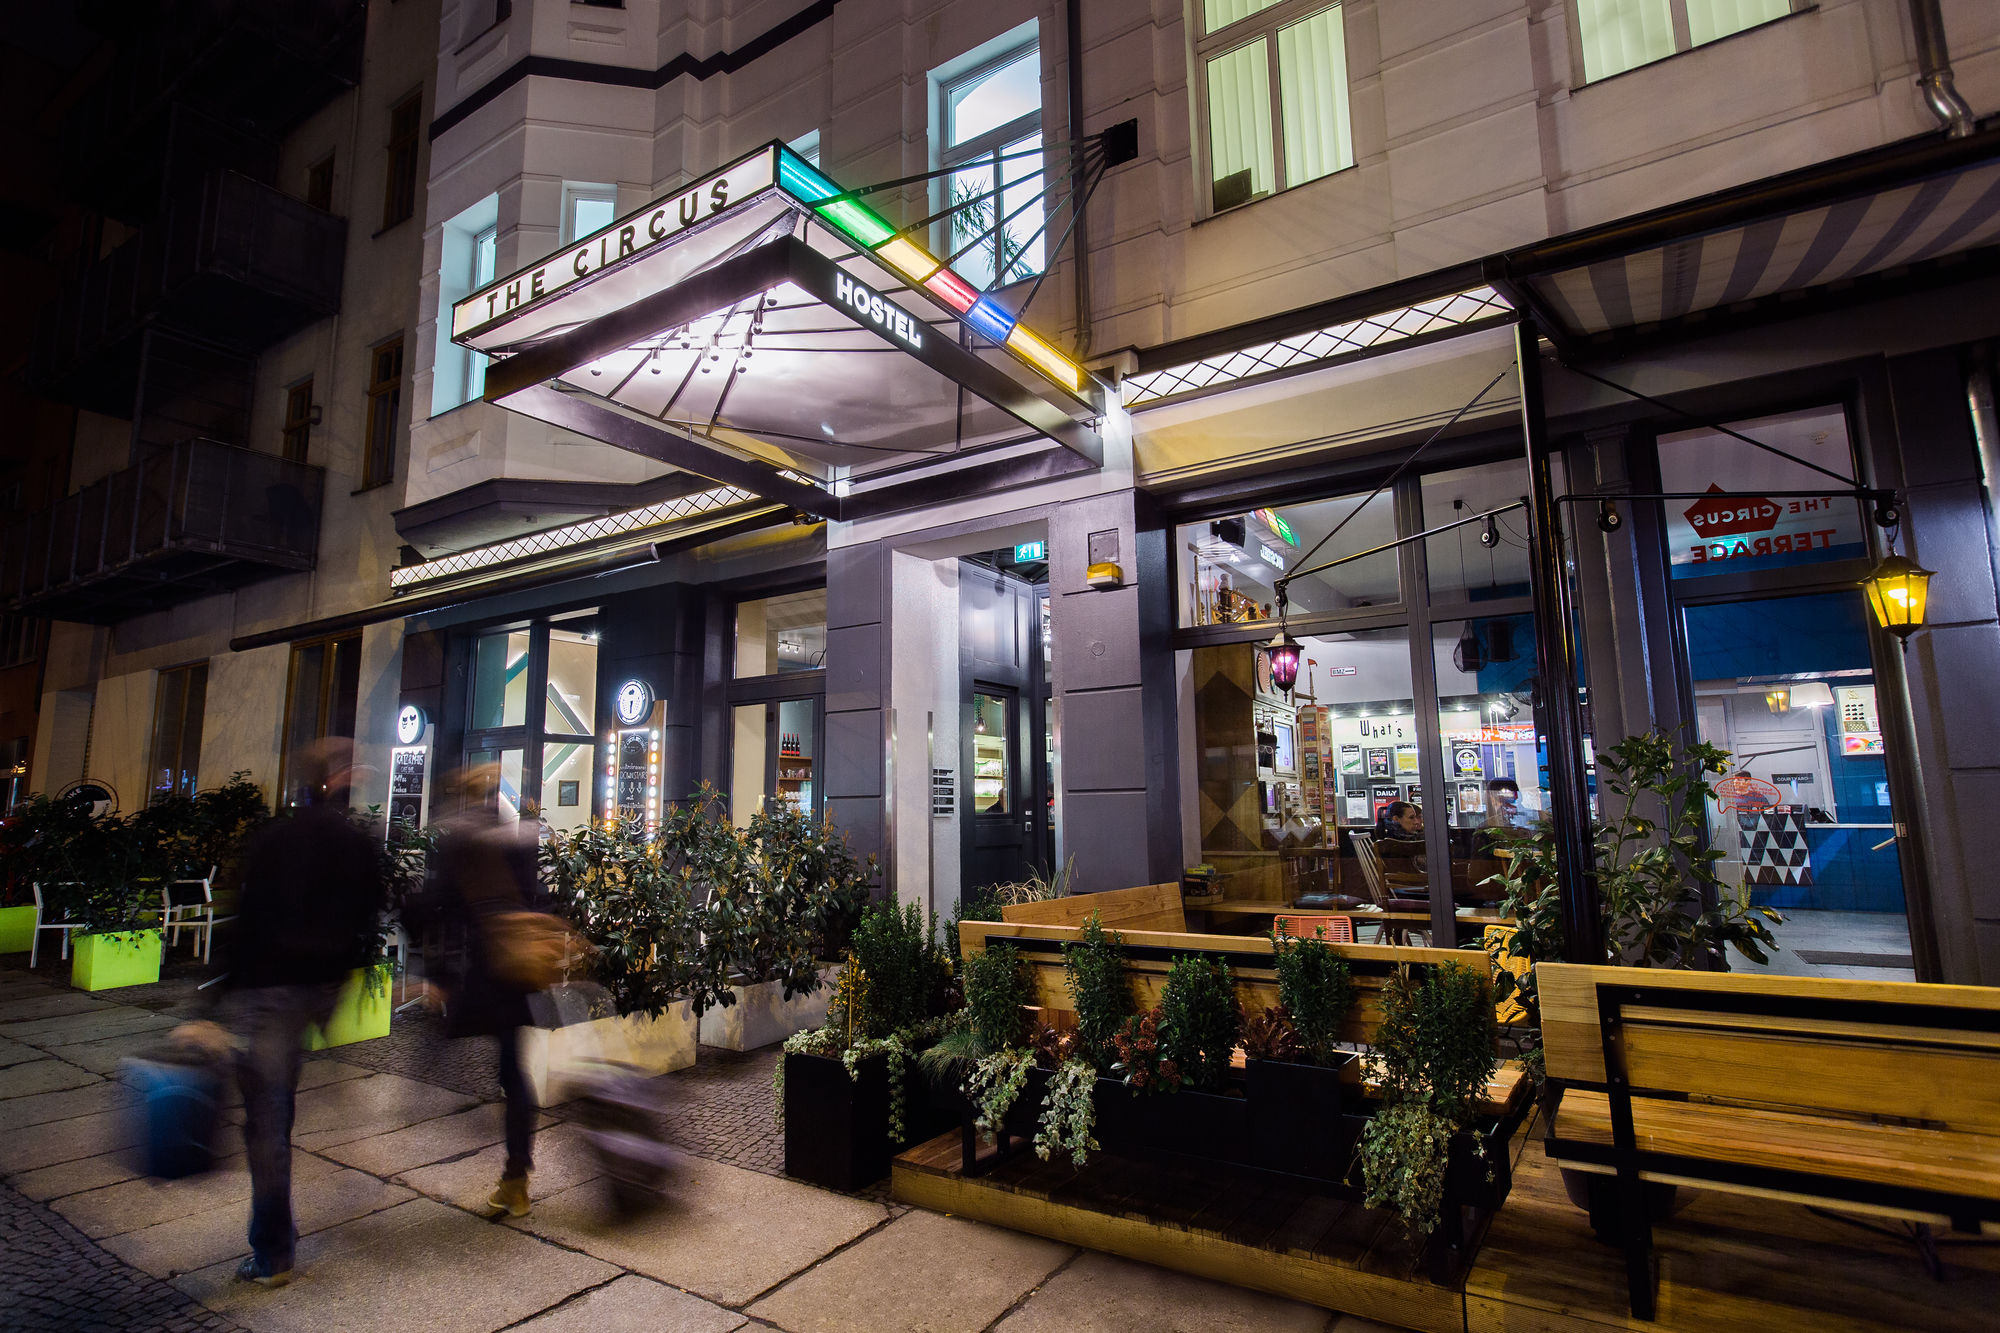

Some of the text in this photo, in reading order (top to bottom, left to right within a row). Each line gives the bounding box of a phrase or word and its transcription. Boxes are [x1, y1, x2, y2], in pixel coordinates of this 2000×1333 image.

[486, 178, 731, 319] THE CIRCUS
[835, 272, 922, 349] HOSTEL
[1360, 719, 1402, 738] What's
